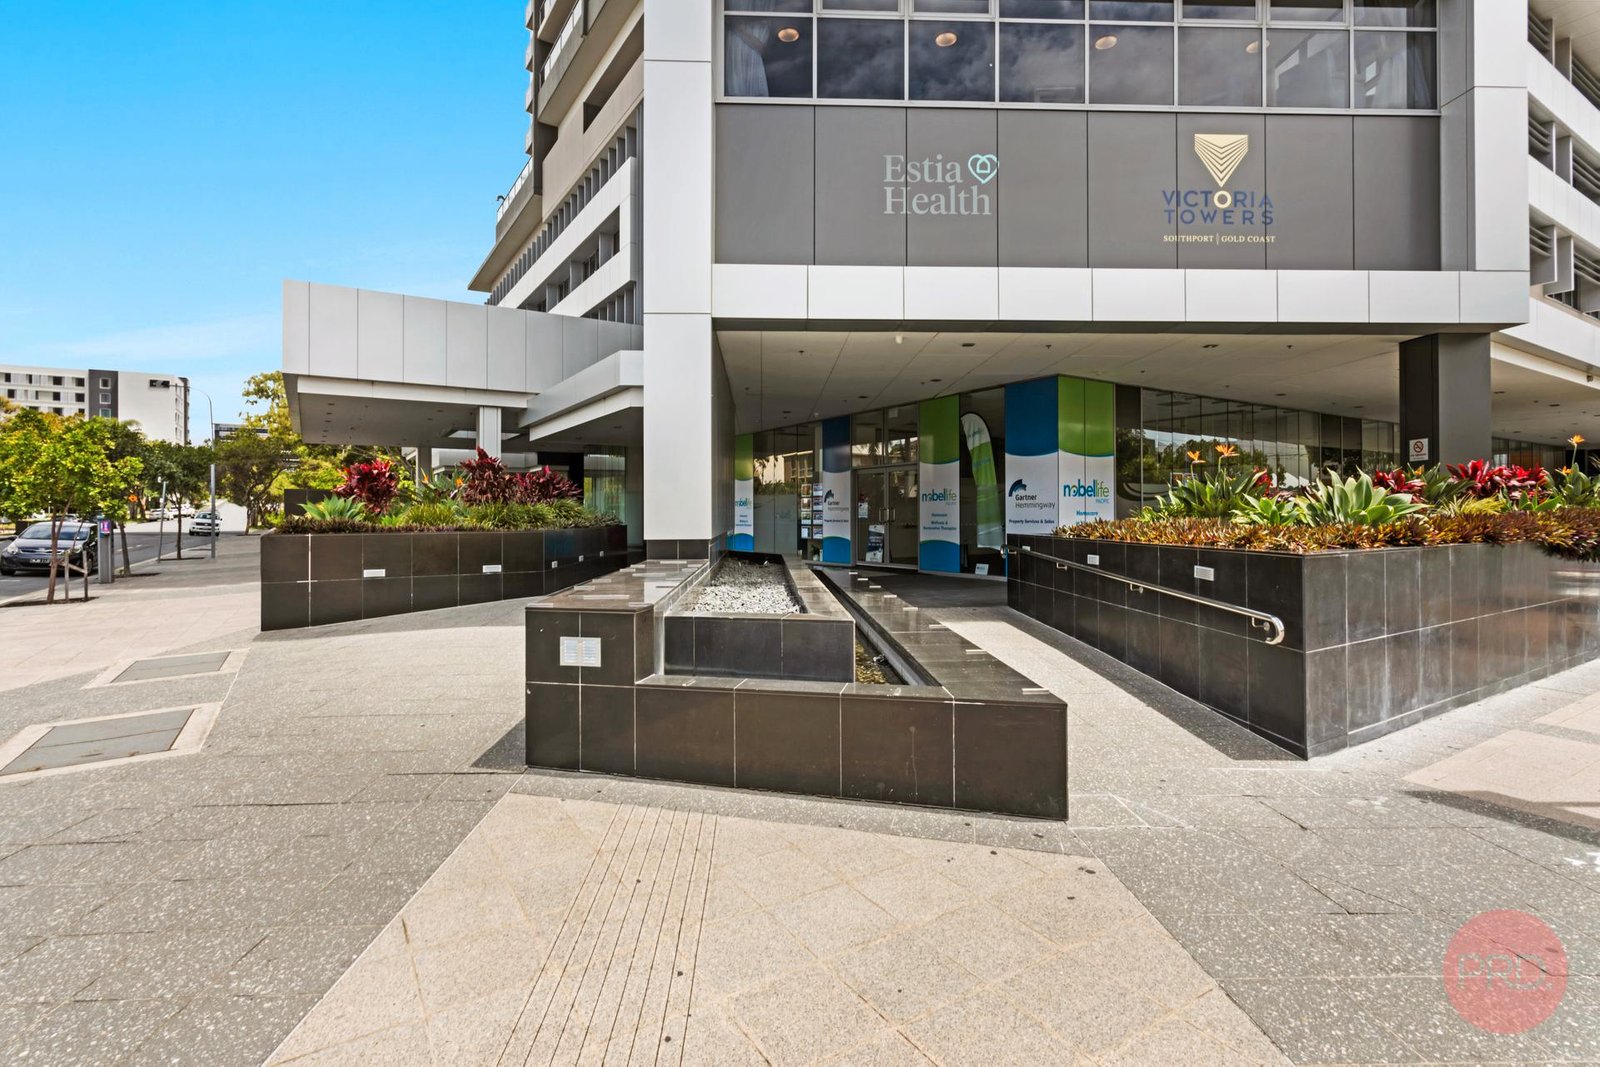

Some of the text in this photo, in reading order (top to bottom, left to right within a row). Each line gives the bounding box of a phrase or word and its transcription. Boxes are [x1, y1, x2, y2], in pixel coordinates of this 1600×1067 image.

[883, 154, 963, 183] Estia
[883, 185, 992, 215] Health
[1162, 190, 1274, 208] VICTORIA
[1164, 209, 1274, 225] TOWERS
[1221, 235, 1245, 243] GOLD
[1247, 235, 1276, 243] COAST
[1015, 501, 1056, 509] Hemmingway
